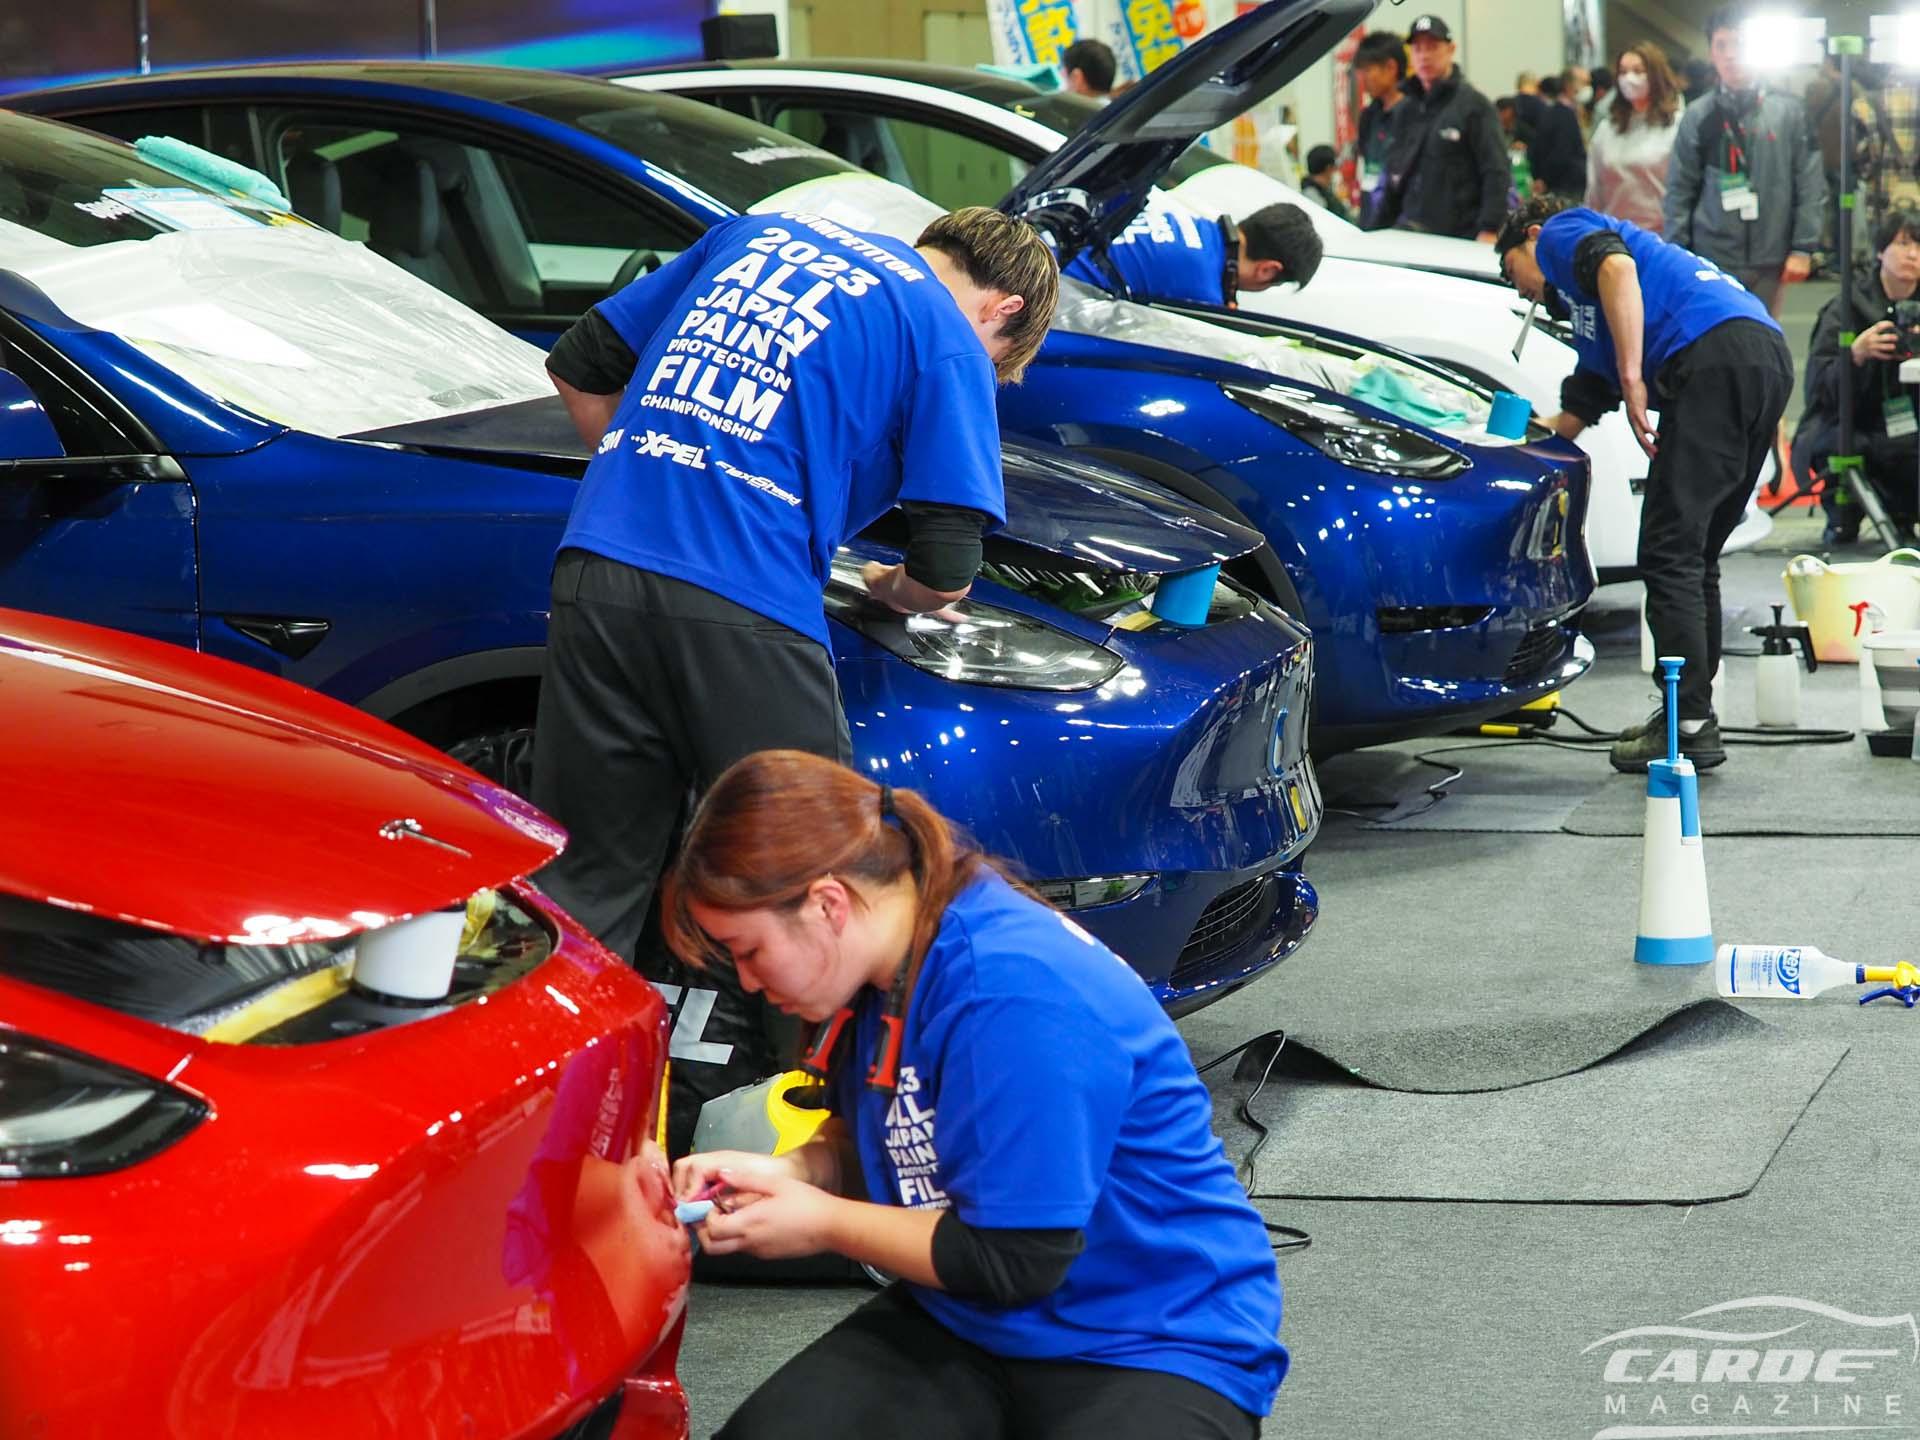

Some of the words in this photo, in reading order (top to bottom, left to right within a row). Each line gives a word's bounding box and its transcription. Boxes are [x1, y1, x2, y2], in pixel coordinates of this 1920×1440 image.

[746, 227, 881, 297] 2023
[780, 211, 925, 282] COMPETITOR
[695, 285, 820, 354] JAPAN
[712, 252, 831, 332] ALL
[666, 338, 792, 391] PROTECTION
[677, 310, 801, 371] PAINT
[640, 394, 764, 443] CHAMPIONSHIP
[646, 355, 784, 431] FILM
[598, 428, 625, 454] 3M
[636, 430, 707, 470] XPEL
[884, 1094, 935, 1128] ALL
